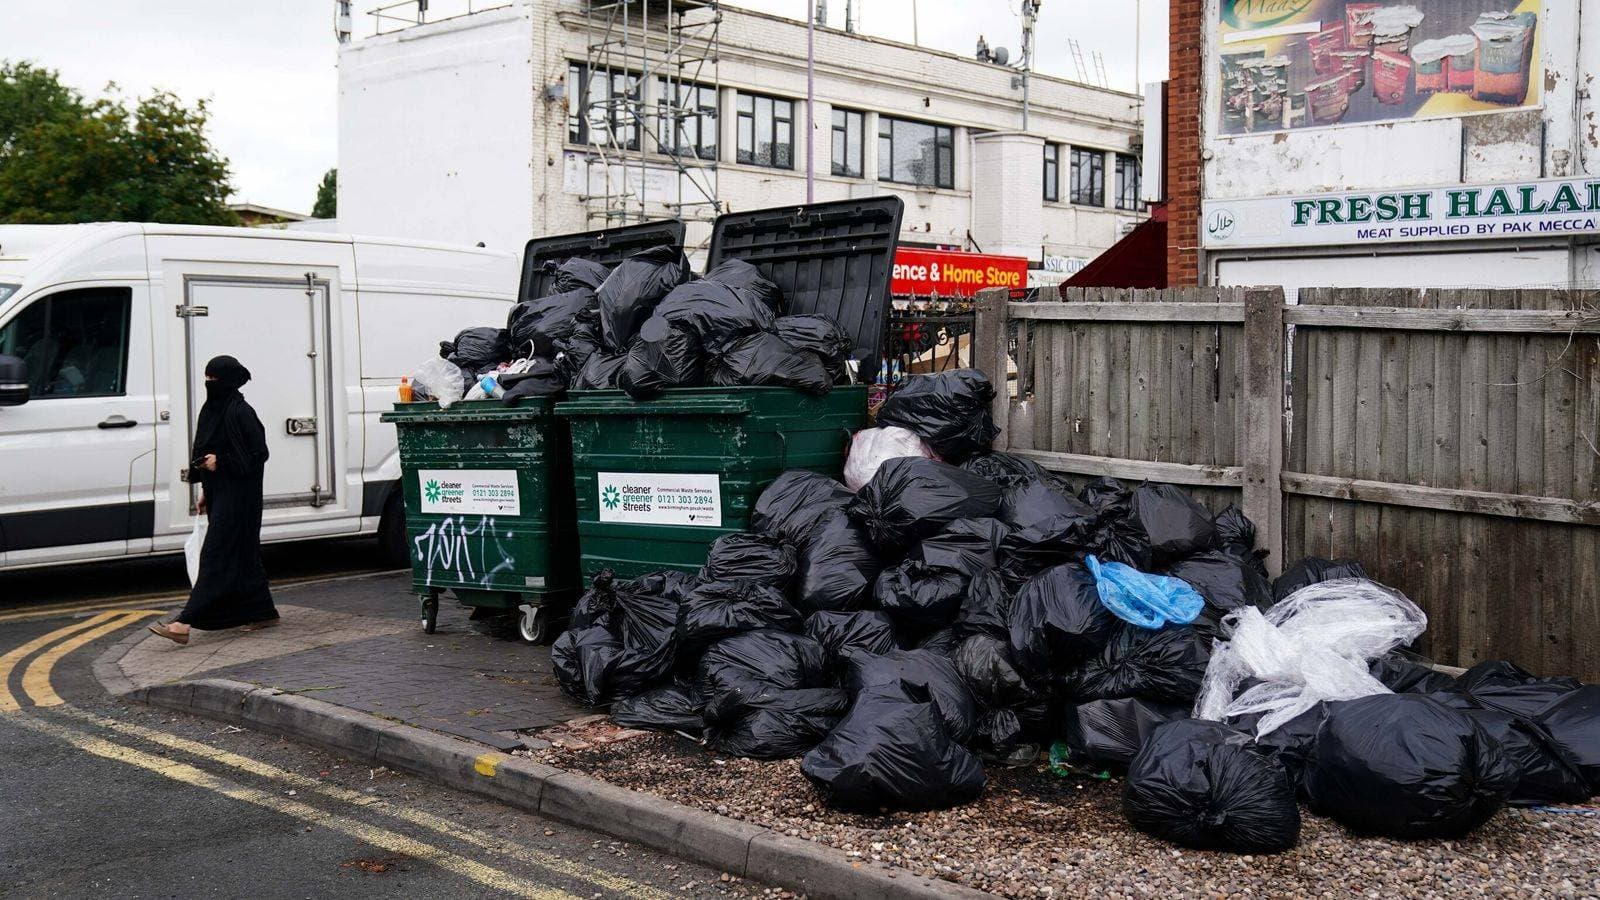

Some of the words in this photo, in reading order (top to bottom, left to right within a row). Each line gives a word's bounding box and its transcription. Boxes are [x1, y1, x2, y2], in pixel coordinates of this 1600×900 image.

[1292, 191, 1432, 227] FRESH
[1357, 227, 1394, 239] MEAT
[1400, 225, 1470, 237] SUPPLIED
[1477, 223, 1496, 234] BY
[1503, 221, 1532, 233] PAK
[1539, 218, 1595, 231] MECCA
[892, 265, 927, 281] ence
[930, 262, 940, 282] &
[943, 263, 983, 284] Home
[986, 266, 1020, 286] Store
[441, 481, 461, 489] cleaner
[622, 484, 651, 494] cleaner
[472, 489, 486, 497] 0121
[488, 489, 499, 497] 303
[623, 494, 653, 503] greener
[657, 494, 675, 503] 0121
[678, 495, 692, 504] 303
[694, 495, 713, 505] 2894
[623, 503, 651, 512] streets
